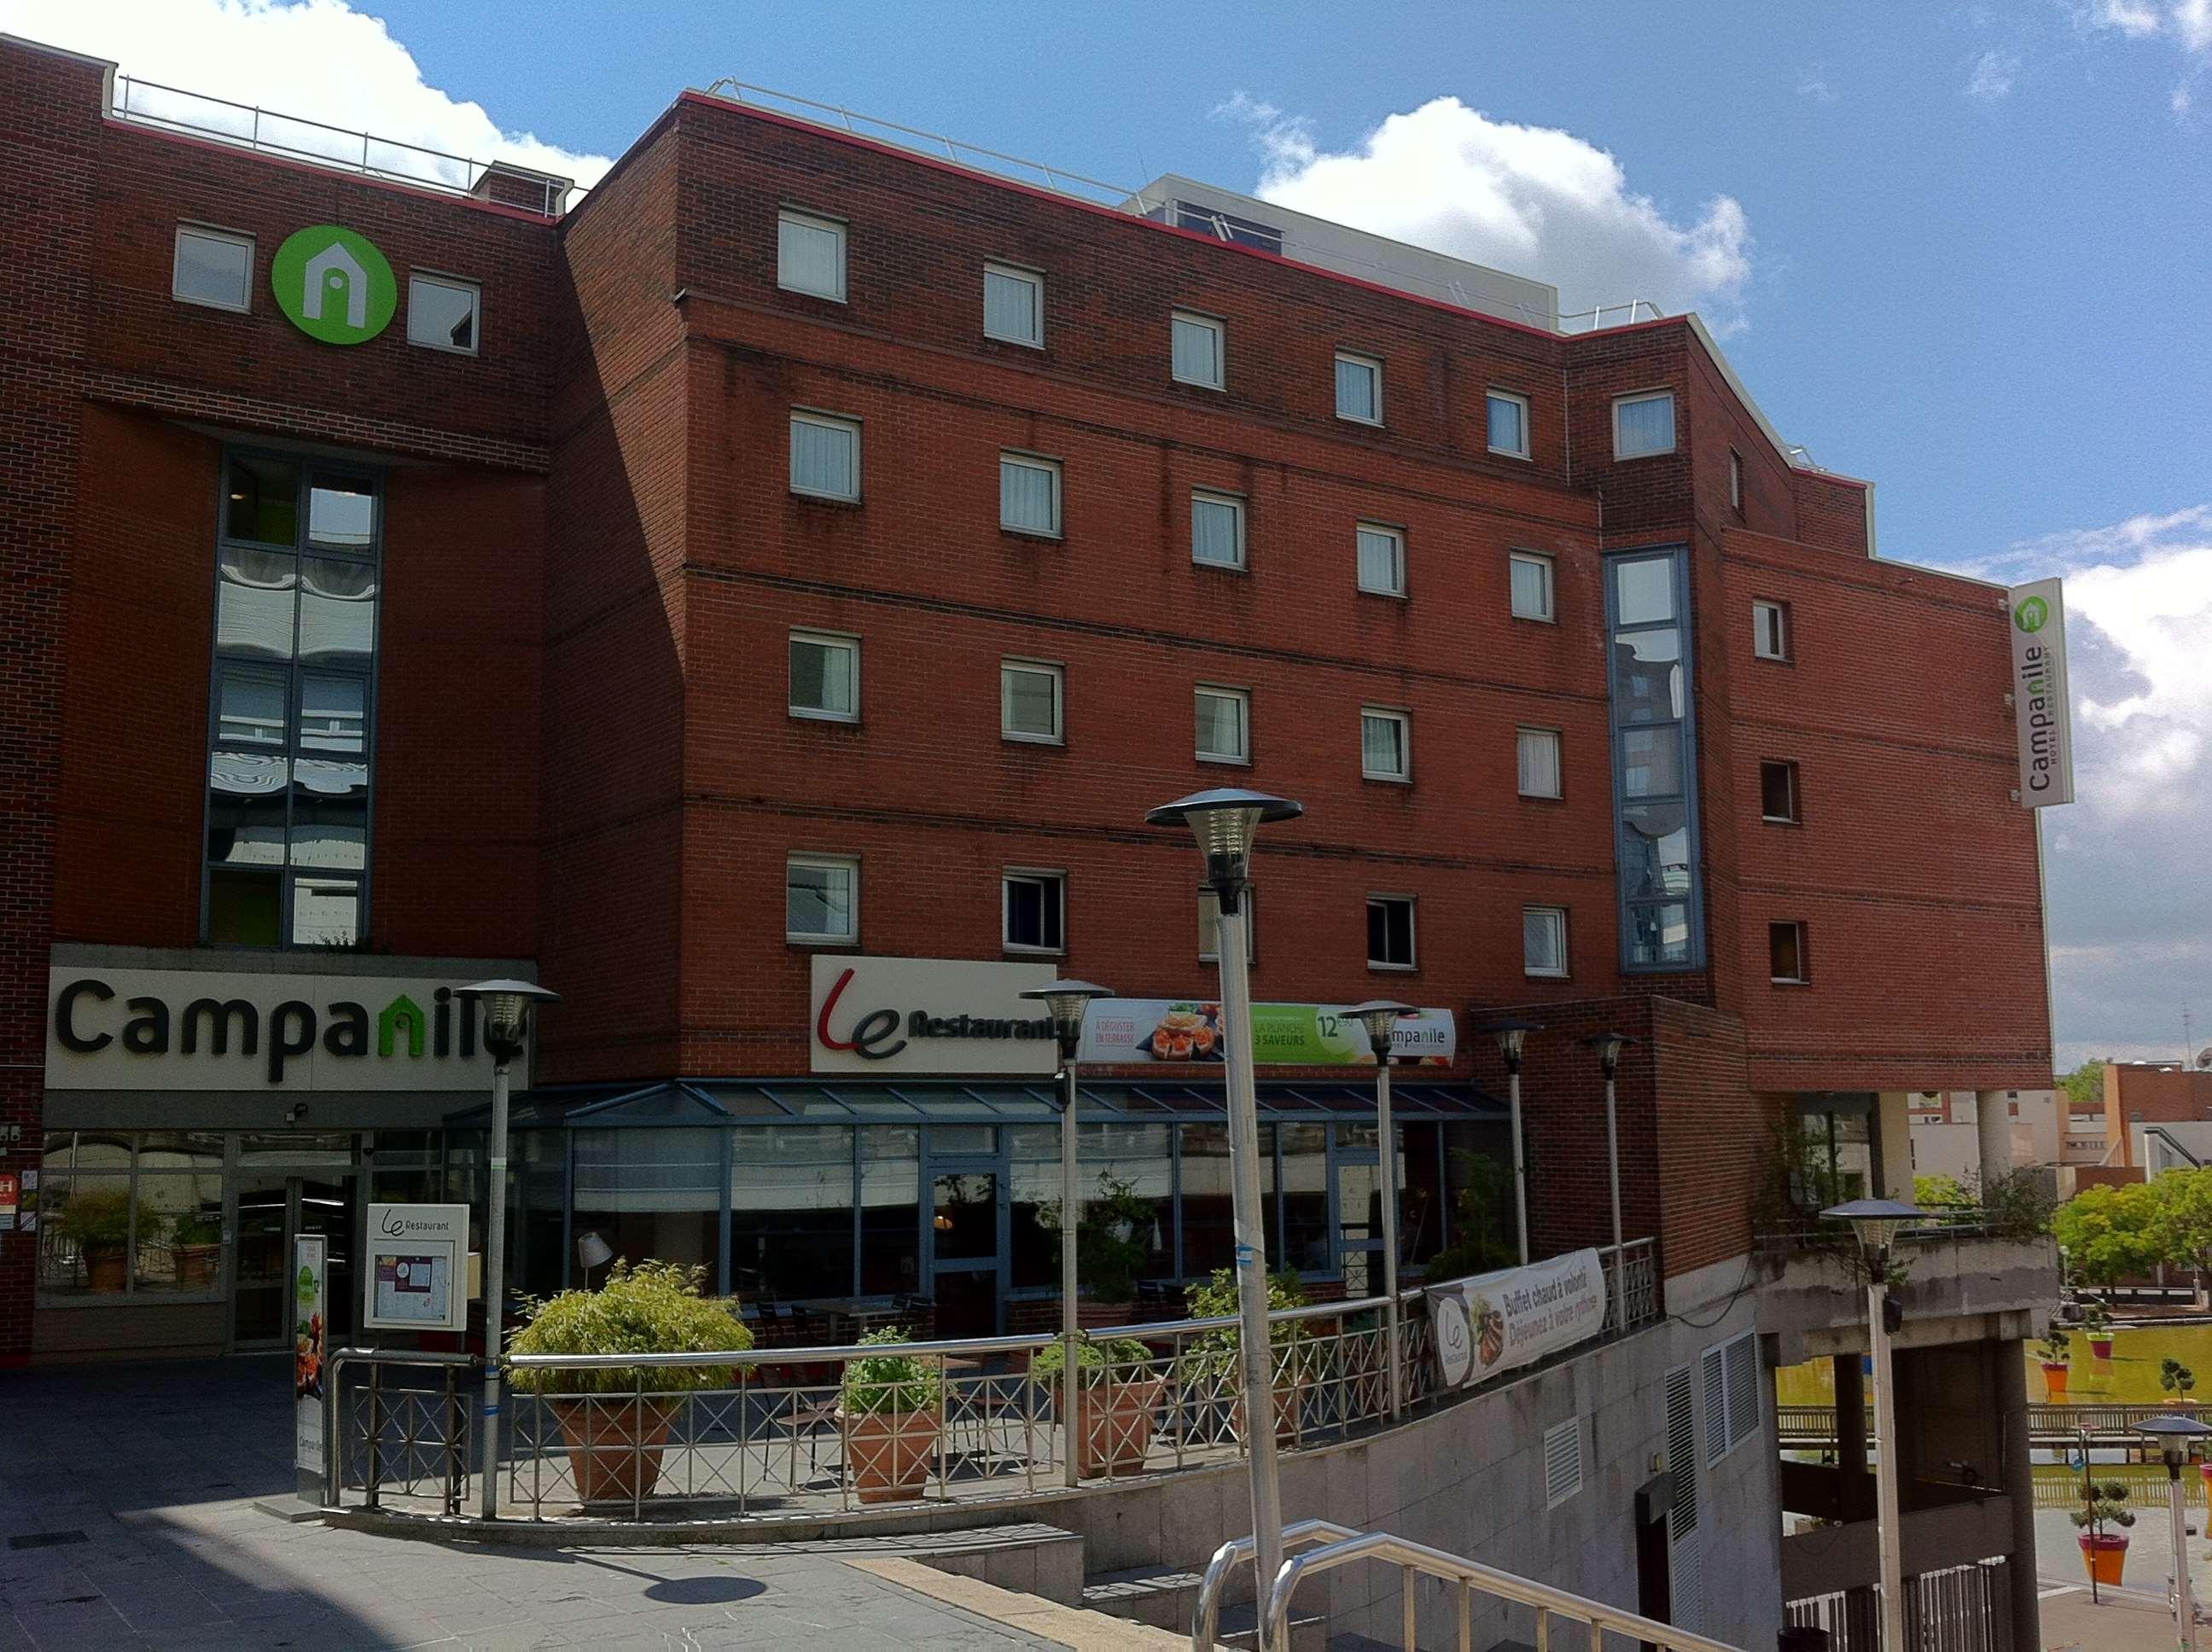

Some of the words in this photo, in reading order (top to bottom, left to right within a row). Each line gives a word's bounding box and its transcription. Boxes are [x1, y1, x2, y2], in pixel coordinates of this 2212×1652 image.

[2021, 646, 2054, 792] Campanile
[818, 969, 907, 1060] Le
[908, 1009, 1057, 1040] Restaurant
[1262, 1034, 1305, 1045] SAVEURS
[1392, 1028, 1445, 1048] mpanile
[381, 1209, 405, 1236] Le
[405, 1220, 450, 1230] Restaurant
[1502, 1288, 1533, 1318] Buffet
[1533, 1278, 1557, 1308] chaud
